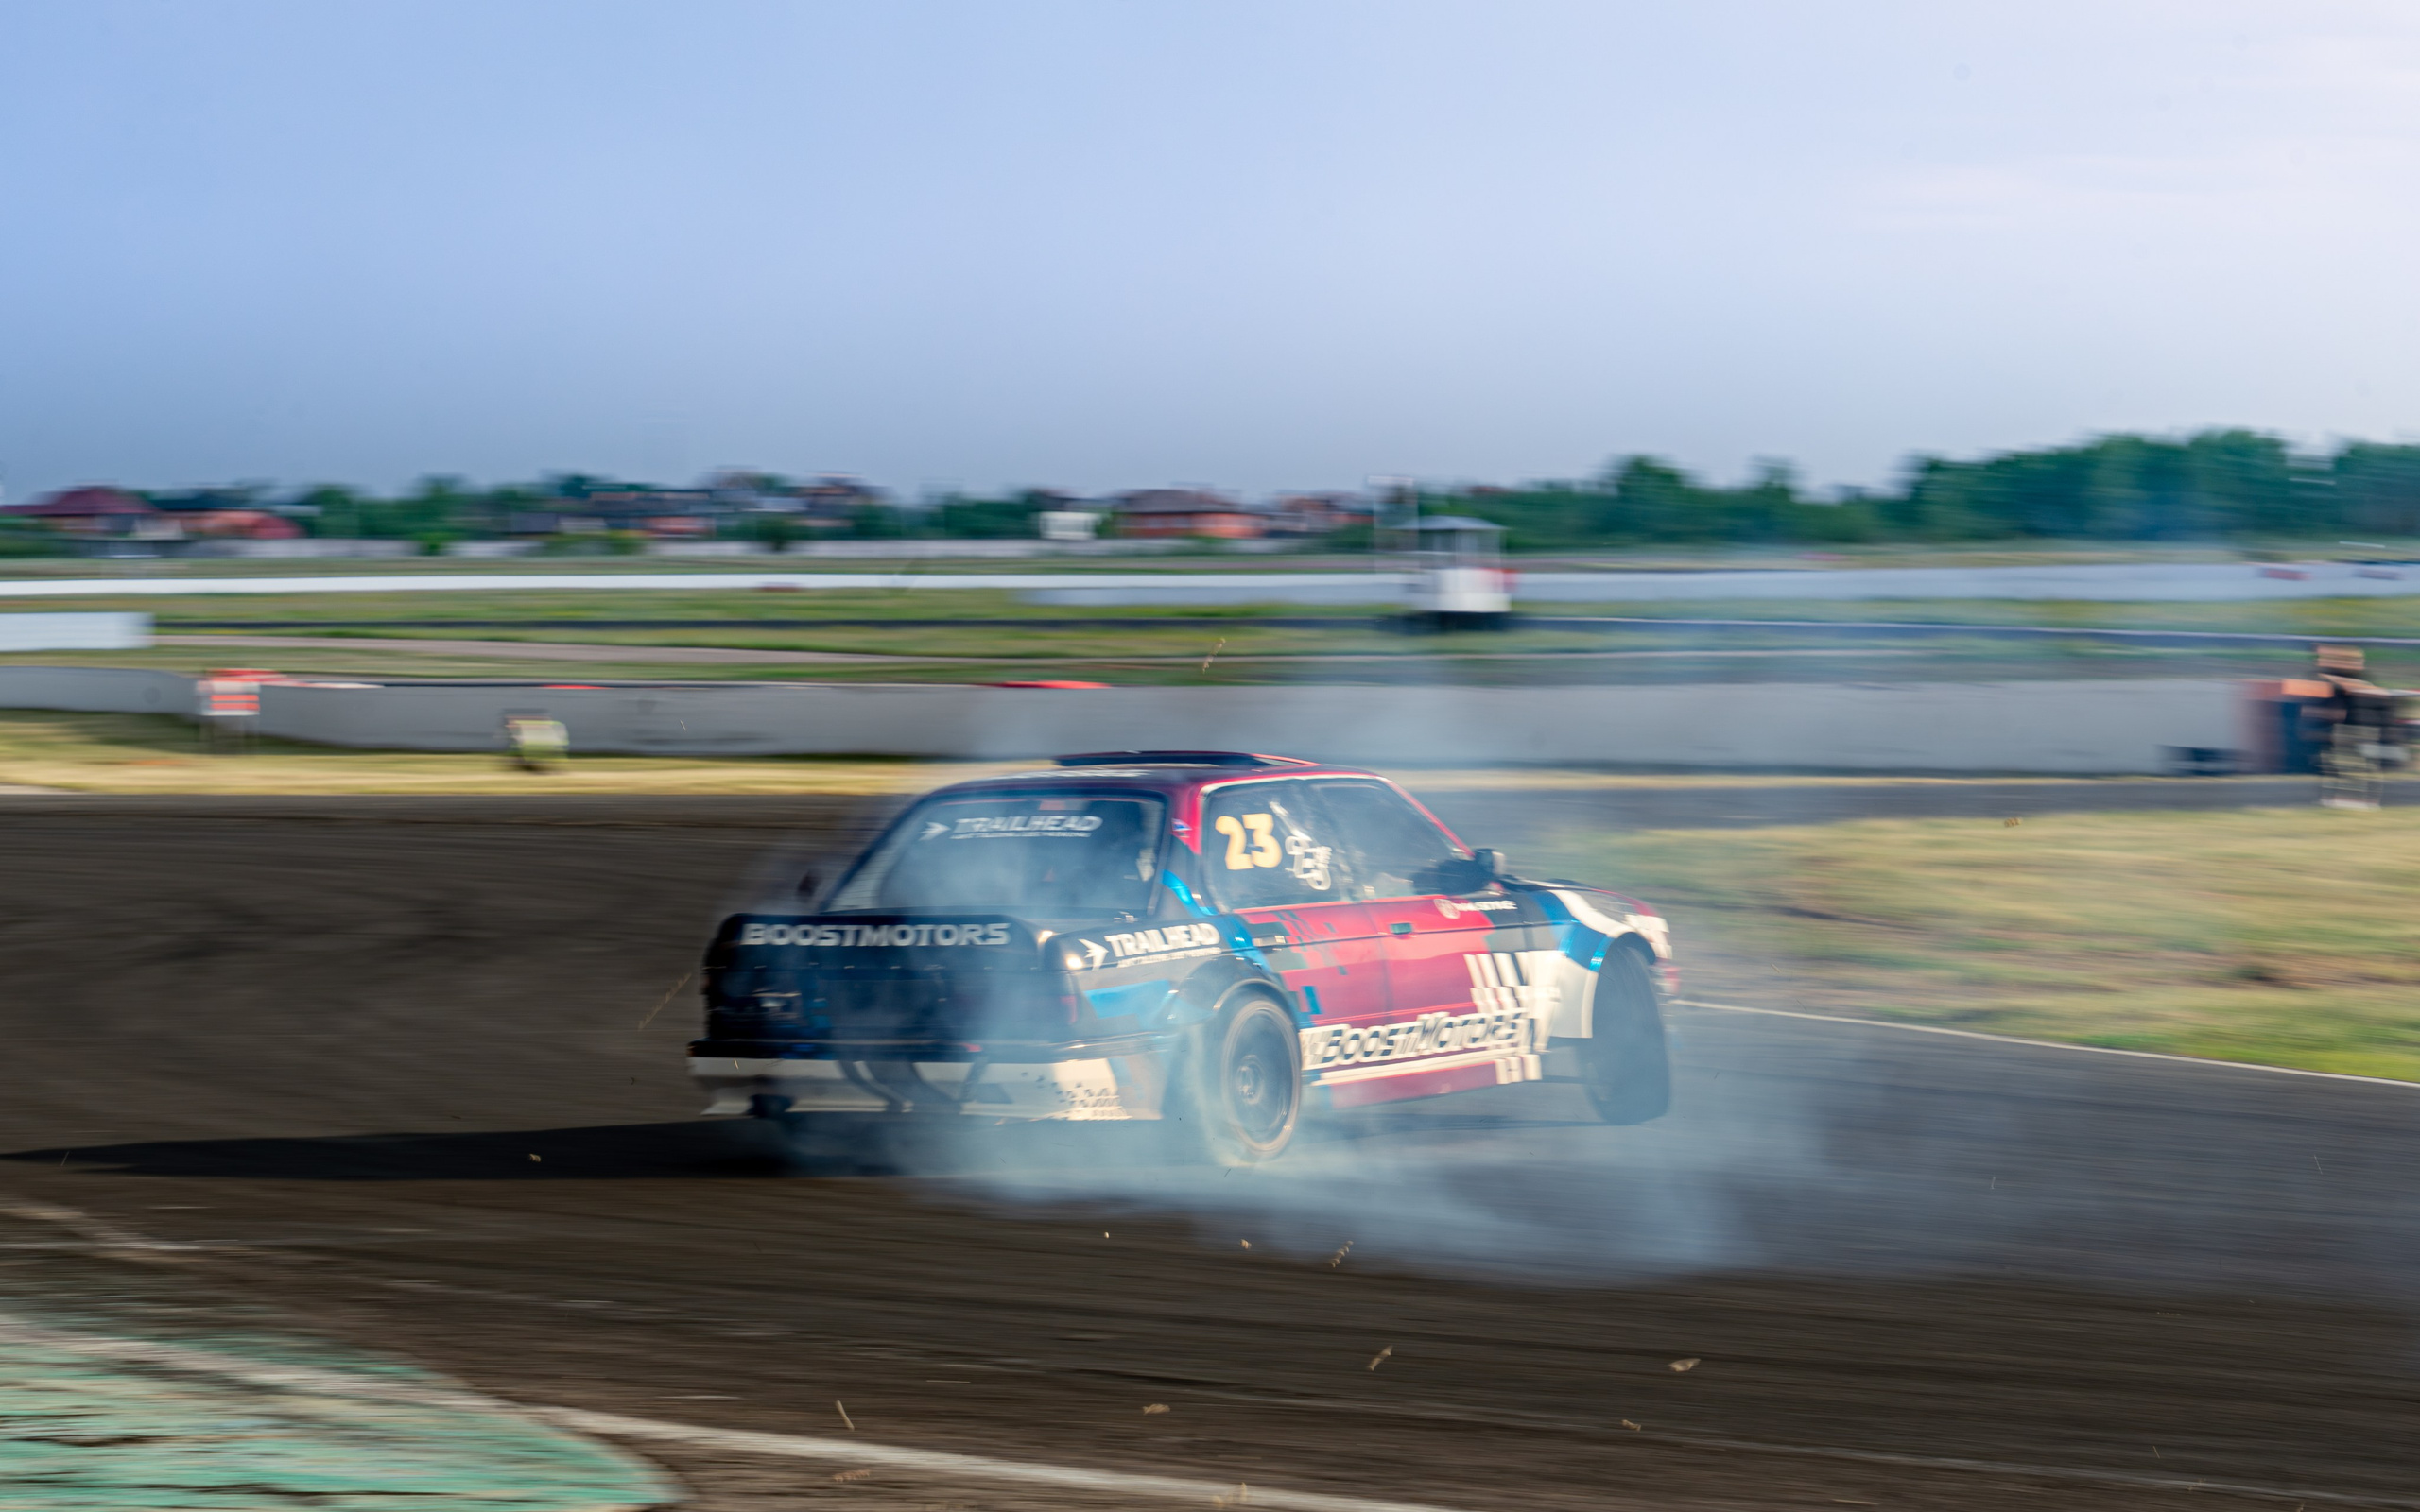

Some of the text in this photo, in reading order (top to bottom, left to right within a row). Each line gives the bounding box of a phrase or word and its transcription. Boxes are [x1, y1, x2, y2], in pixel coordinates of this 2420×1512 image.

[953, 816, 1104, 833] TRAILHEAD
[1215, 813, 1283, 870] 23
[741, 923, 1011, 946] BOOSTMOTORS
[1104, 923, 1220, 957] TRAILHEAD
